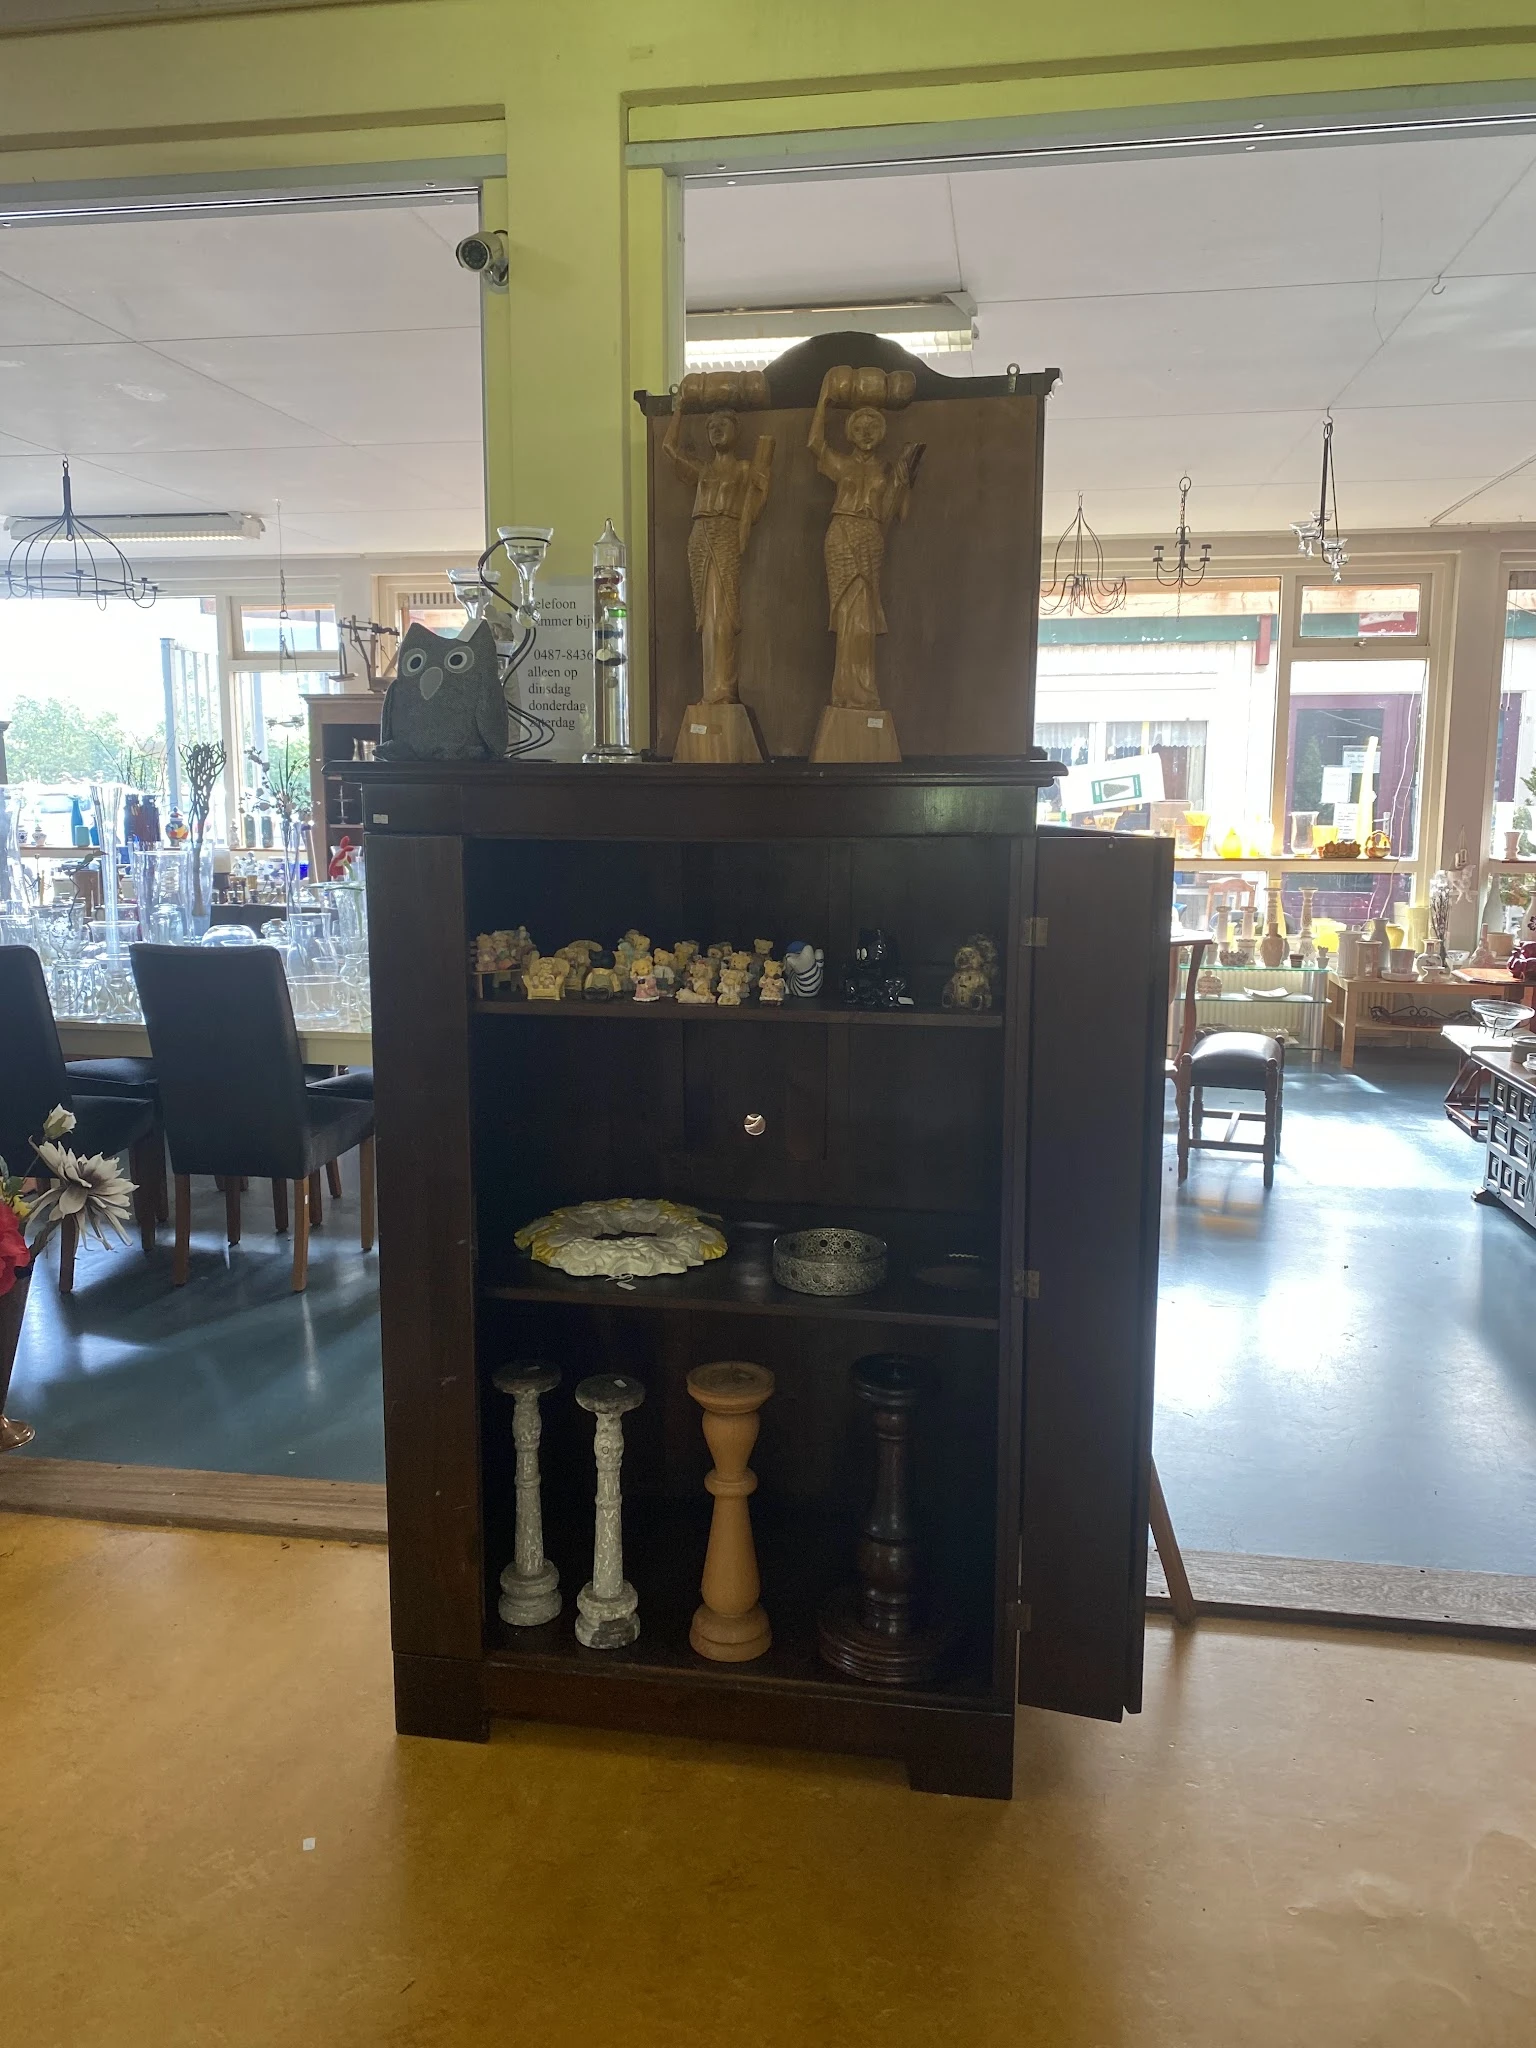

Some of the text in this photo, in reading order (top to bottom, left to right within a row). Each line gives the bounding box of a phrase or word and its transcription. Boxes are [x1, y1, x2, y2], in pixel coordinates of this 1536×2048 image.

[535, 597, 577, 610] elefoon
[527, 666, 578, 680] alleen op
[528, 683, 571, 697] dinsdag
[528, 700, 586, 714] donderdag
